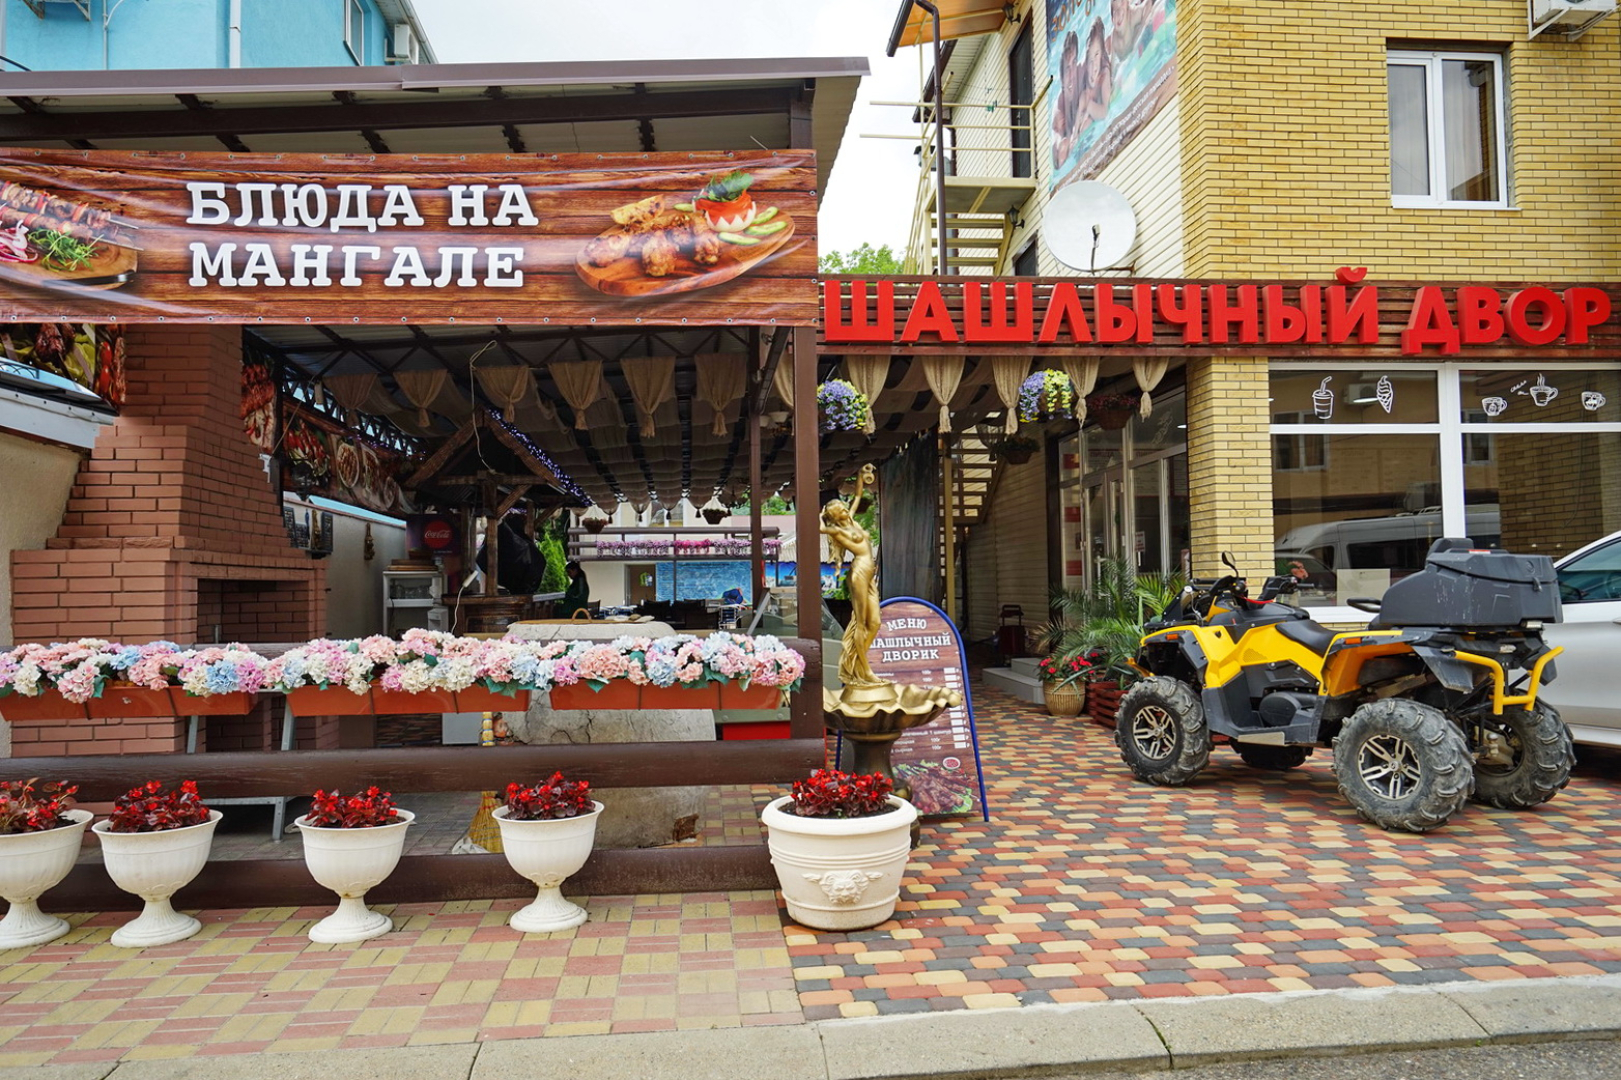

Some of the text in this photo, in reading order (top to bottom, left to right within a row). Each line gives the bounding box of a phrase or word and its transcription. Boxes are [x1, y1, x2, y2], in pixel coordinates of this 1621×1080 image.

[186, 182, 540, 233] БЛЮДА НА
[188, 241, 526, 289] МАНГАЛЕ
[824, 267, 1612, 356] ШАШЛЫЧНЫЙ ДВОР
[886, 617, 927, 632] МЕНЮ
[882, 649, 940, 663] ДВОРИК
